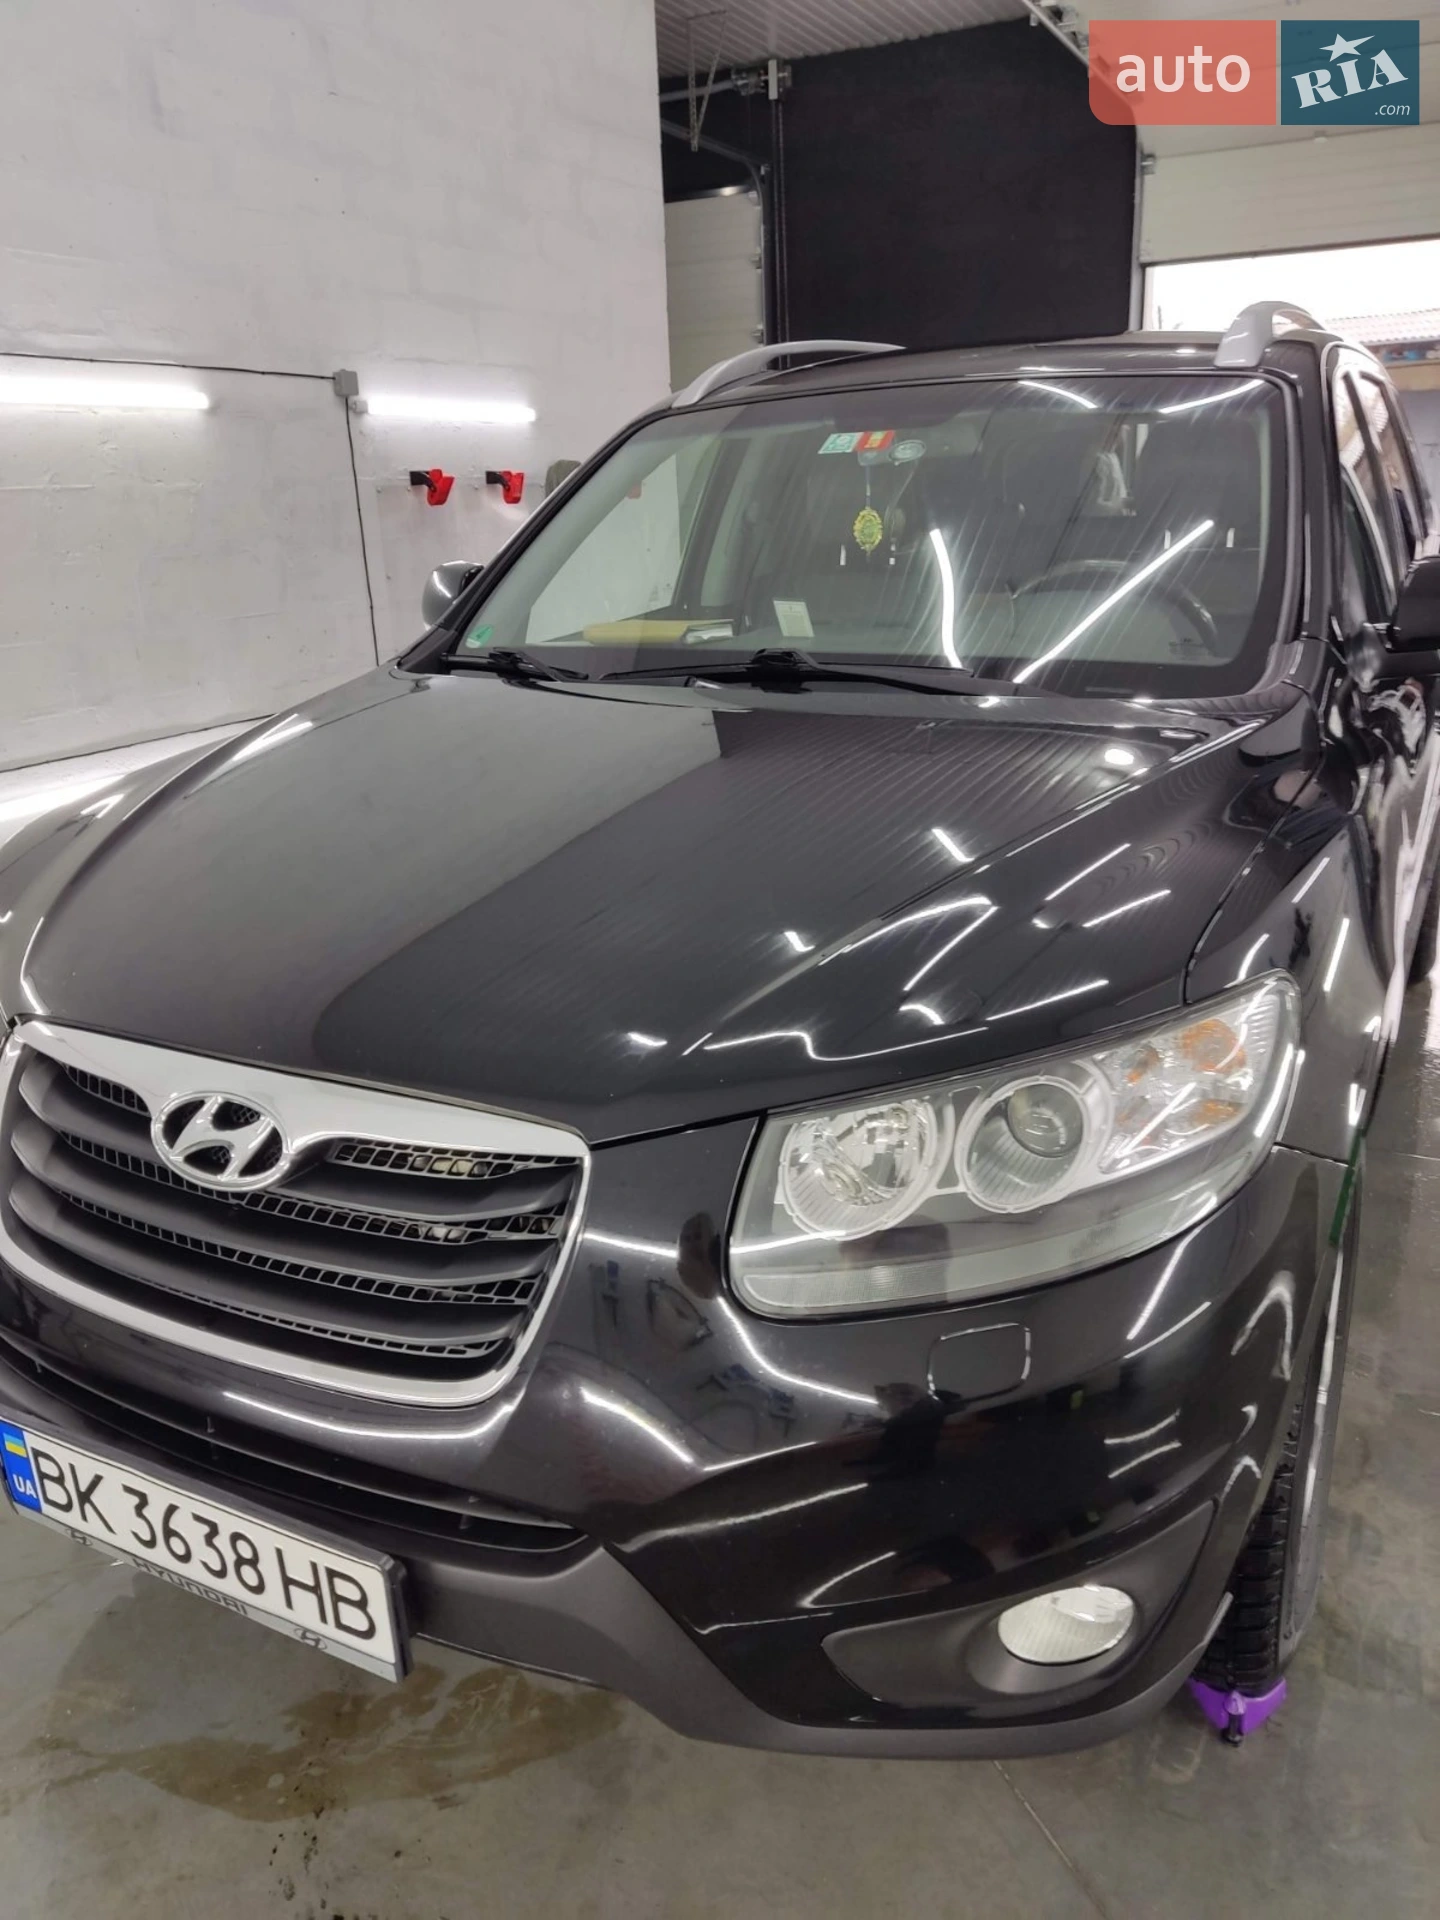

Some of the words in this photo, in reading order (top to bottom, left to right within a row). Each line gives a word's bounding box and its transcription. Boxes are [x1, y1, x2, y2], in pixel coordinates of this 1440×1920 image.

[12, 1473, 38, 1499] UA
[30, 1446, 118, 1536] BK
[121, 1482, 266, 1596] 3638
[274, 1546, 377, 1640] HB
